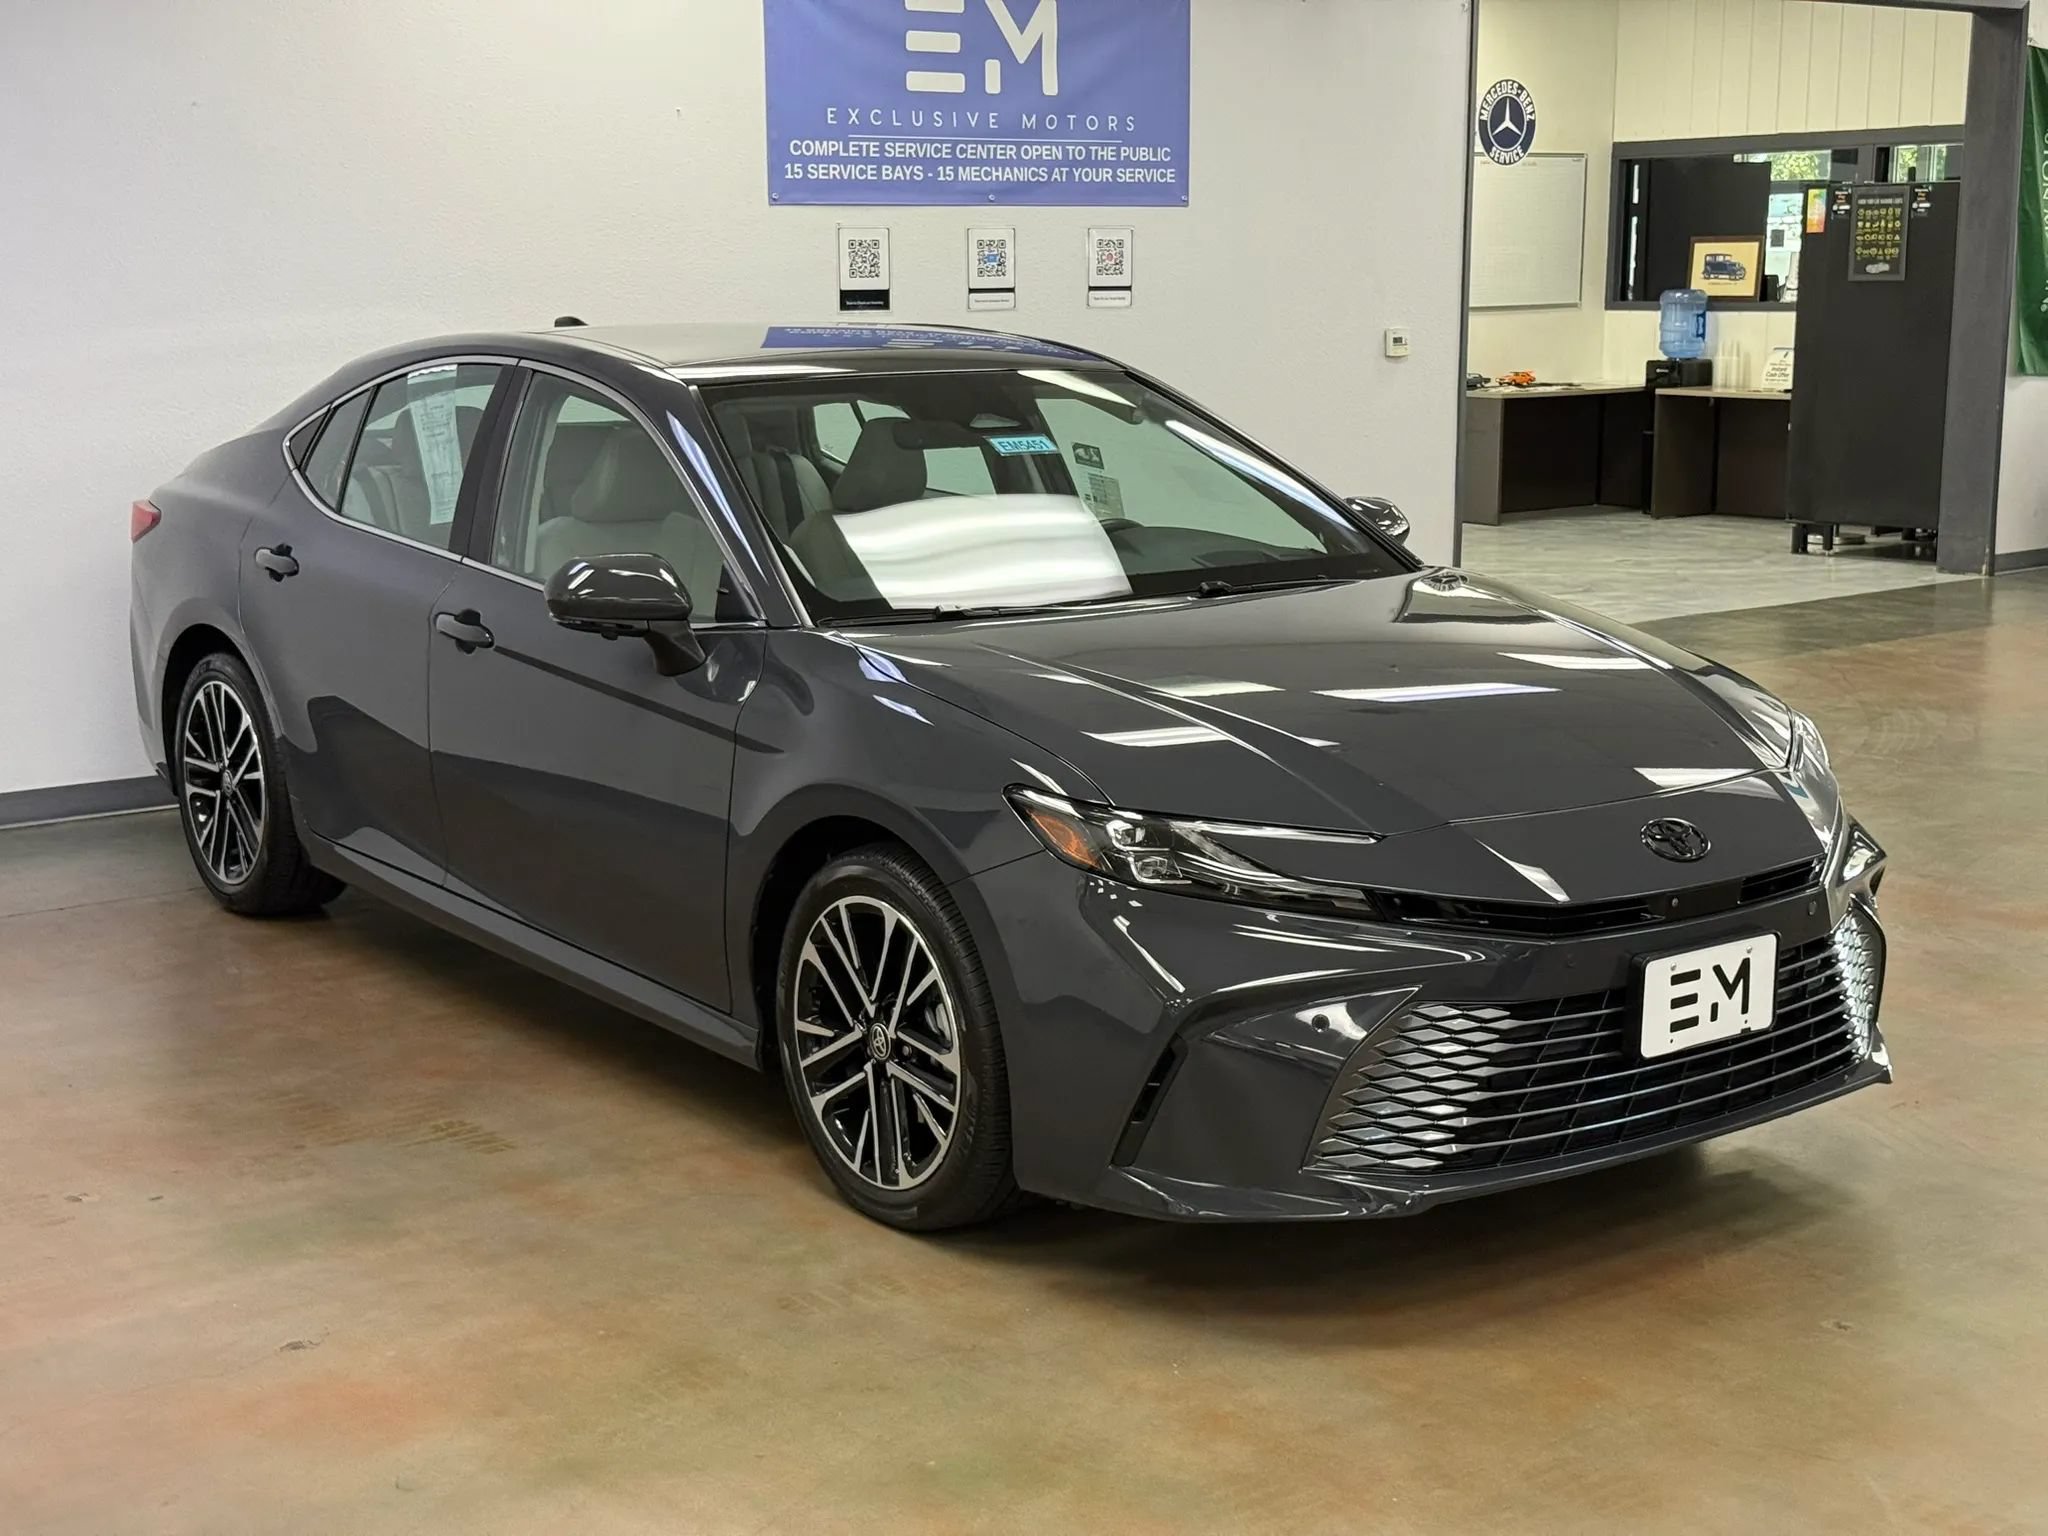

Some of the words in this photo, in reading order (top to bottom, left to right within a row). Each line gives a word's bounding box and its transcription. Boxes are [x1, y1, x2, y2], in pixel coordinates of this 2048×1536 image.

[905, 0, 1059, 96] EM
[826, 107, 999, 129] EXCLUSIVE
[1021, 113, 1136, 132] MOTORS
[789, 139, 881, 157] COMPLETE
[883, 141, 953, 159] SERVICE
[955, 143, 1017, 160] CENTER
[1020, 144, 1063, 161] OPEN
[1065, 145, 1087, 162] TO
[1088, 146, 1117, 161] THE
[1119, 147, 1172, 162] PUBLIC
[1489, 145, 1525, 165] SERVICE
[783, 162, 803, 179] 15
[806, 163, 878, 181] SERVICE
[880, 165, 924, 181] BAYS
[936, 166, 955, 182] 15
[957, 166, 1049, 182] MECHANICS
[1050, 167, 1070, 182] AT
[1072, 167, 1114, 183] YOUR
[1115, 168, 1177, 184] SERVICE
[997, 438, 1051, 452] EM5451
[1669, 957, 1751, 1034] EM
